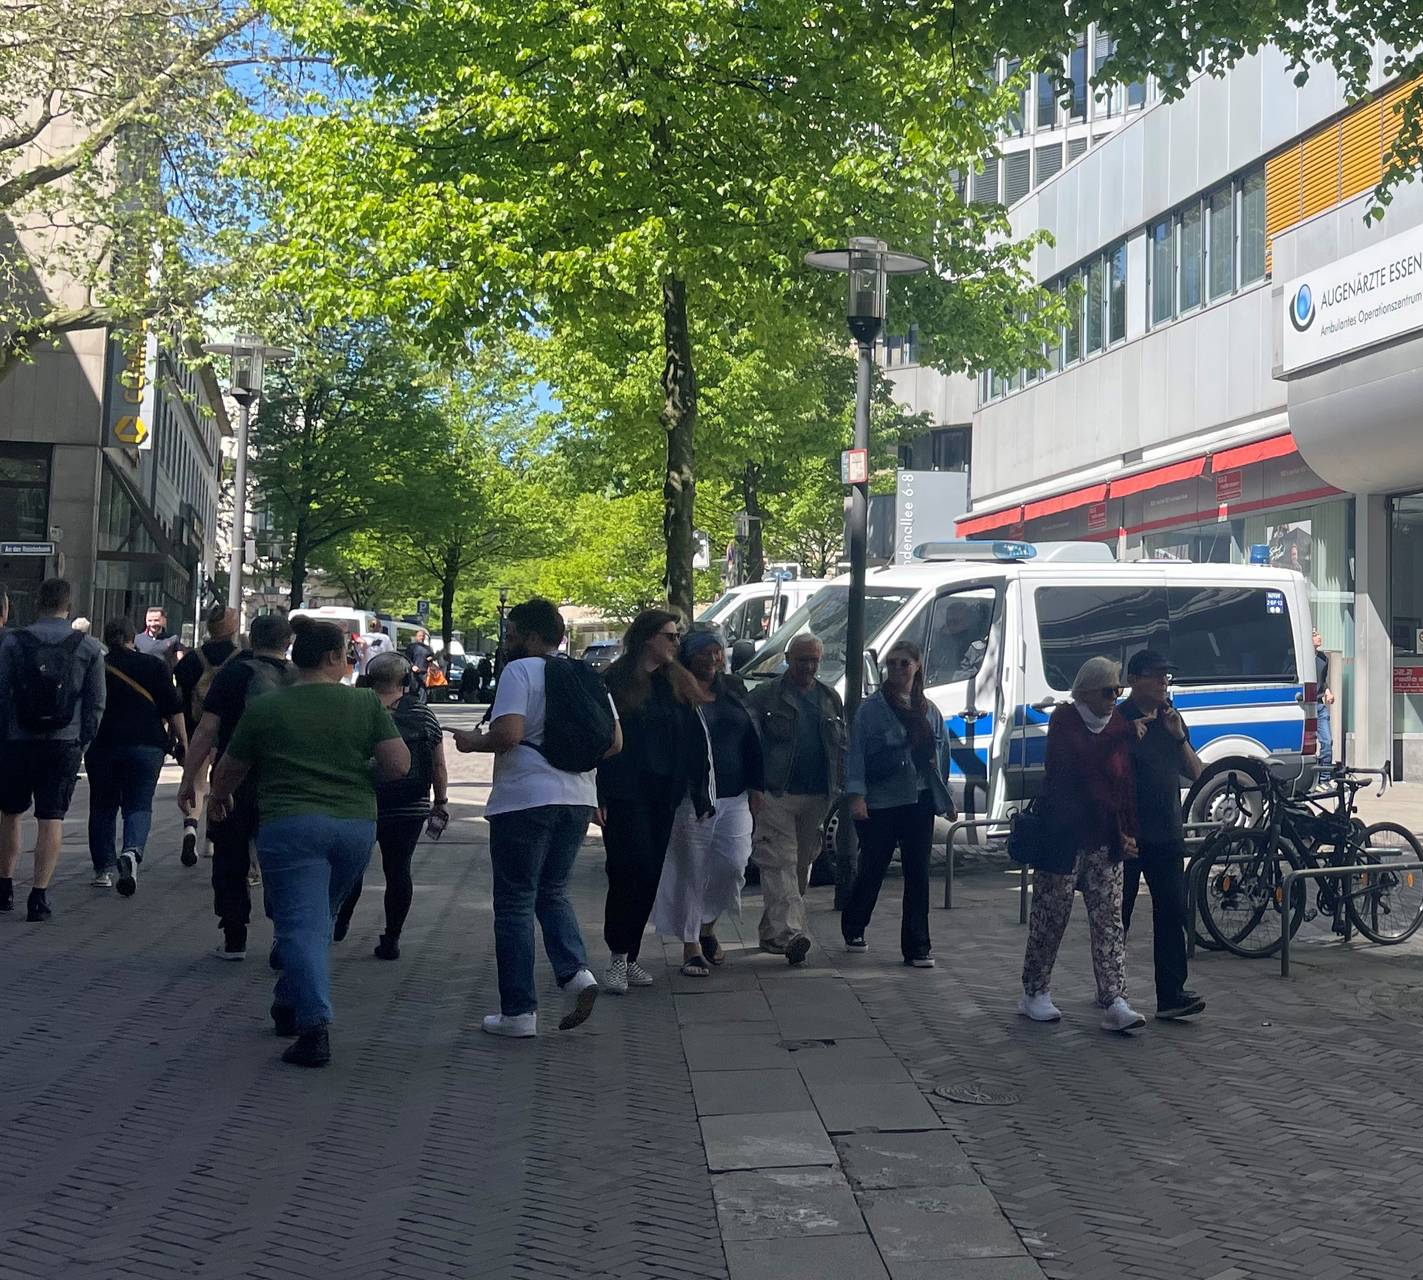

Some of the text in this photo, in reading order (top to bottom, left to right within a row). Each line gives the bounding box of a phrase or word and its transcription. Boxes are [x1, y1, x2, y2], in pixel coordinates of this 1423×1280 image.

[1321, 252, 1423, 310] AUGENÄRZTE ESSEN
[1320, 291, 1423, 337] Ambulantes Operationszentrum
[901, 474, 914, 497] 6-8
